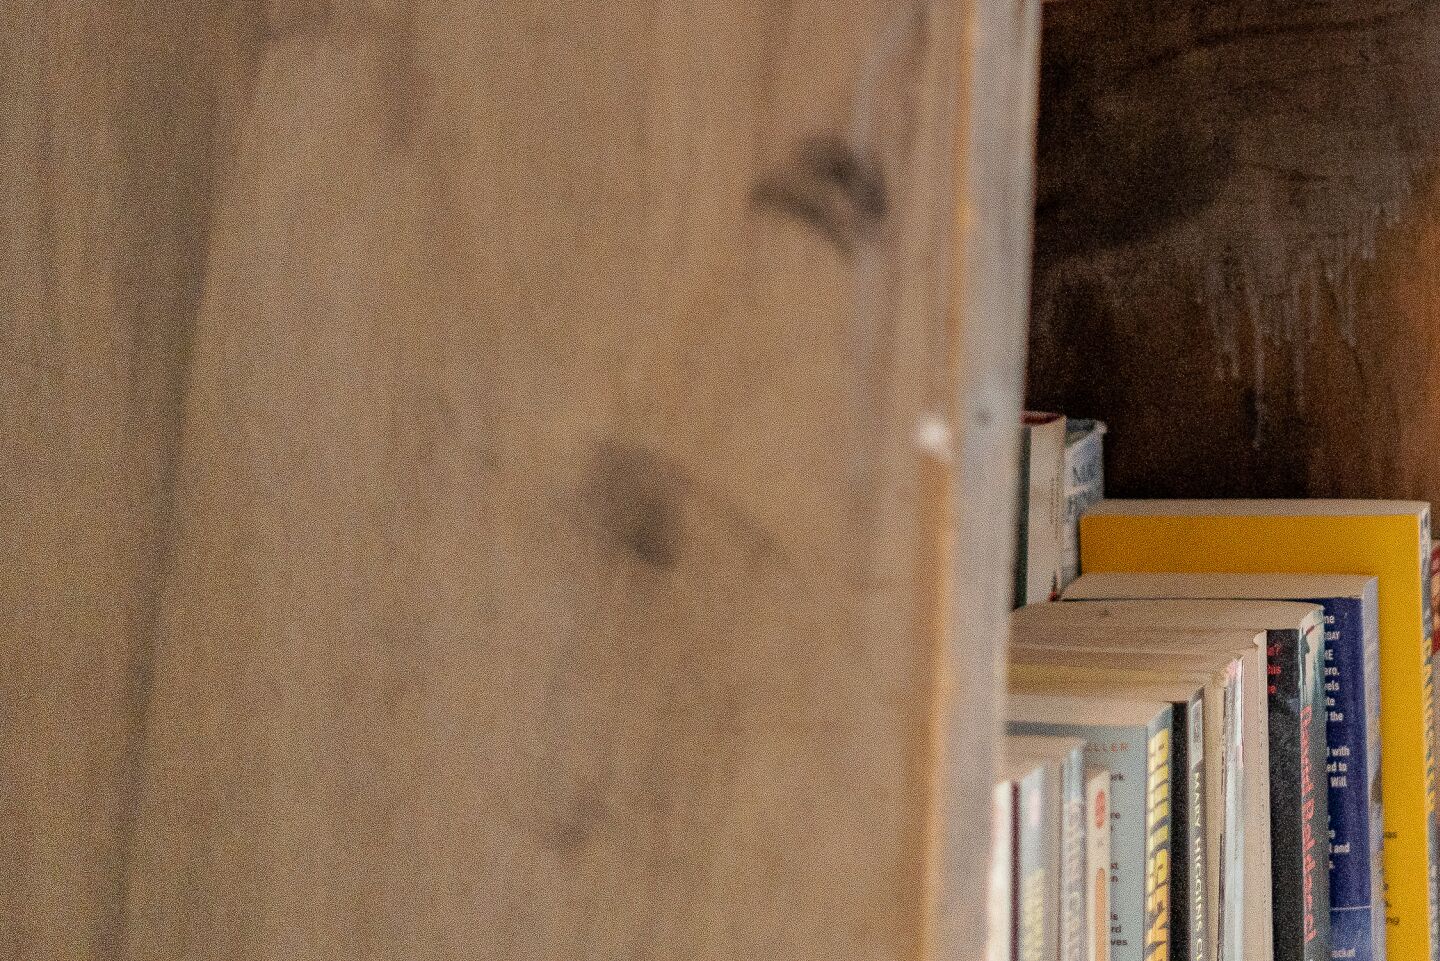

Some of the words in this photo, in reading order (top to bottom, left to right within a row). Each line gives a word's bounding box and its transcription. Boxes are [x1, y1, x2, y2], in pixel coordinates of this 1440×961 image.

[1300, 704, 1315, 796] David
[1194, 772, 1202, 827] MARY
[1194, 837, 1204, 932] HIGGINS
[1302, 798, 1319, 943] Baldacci
